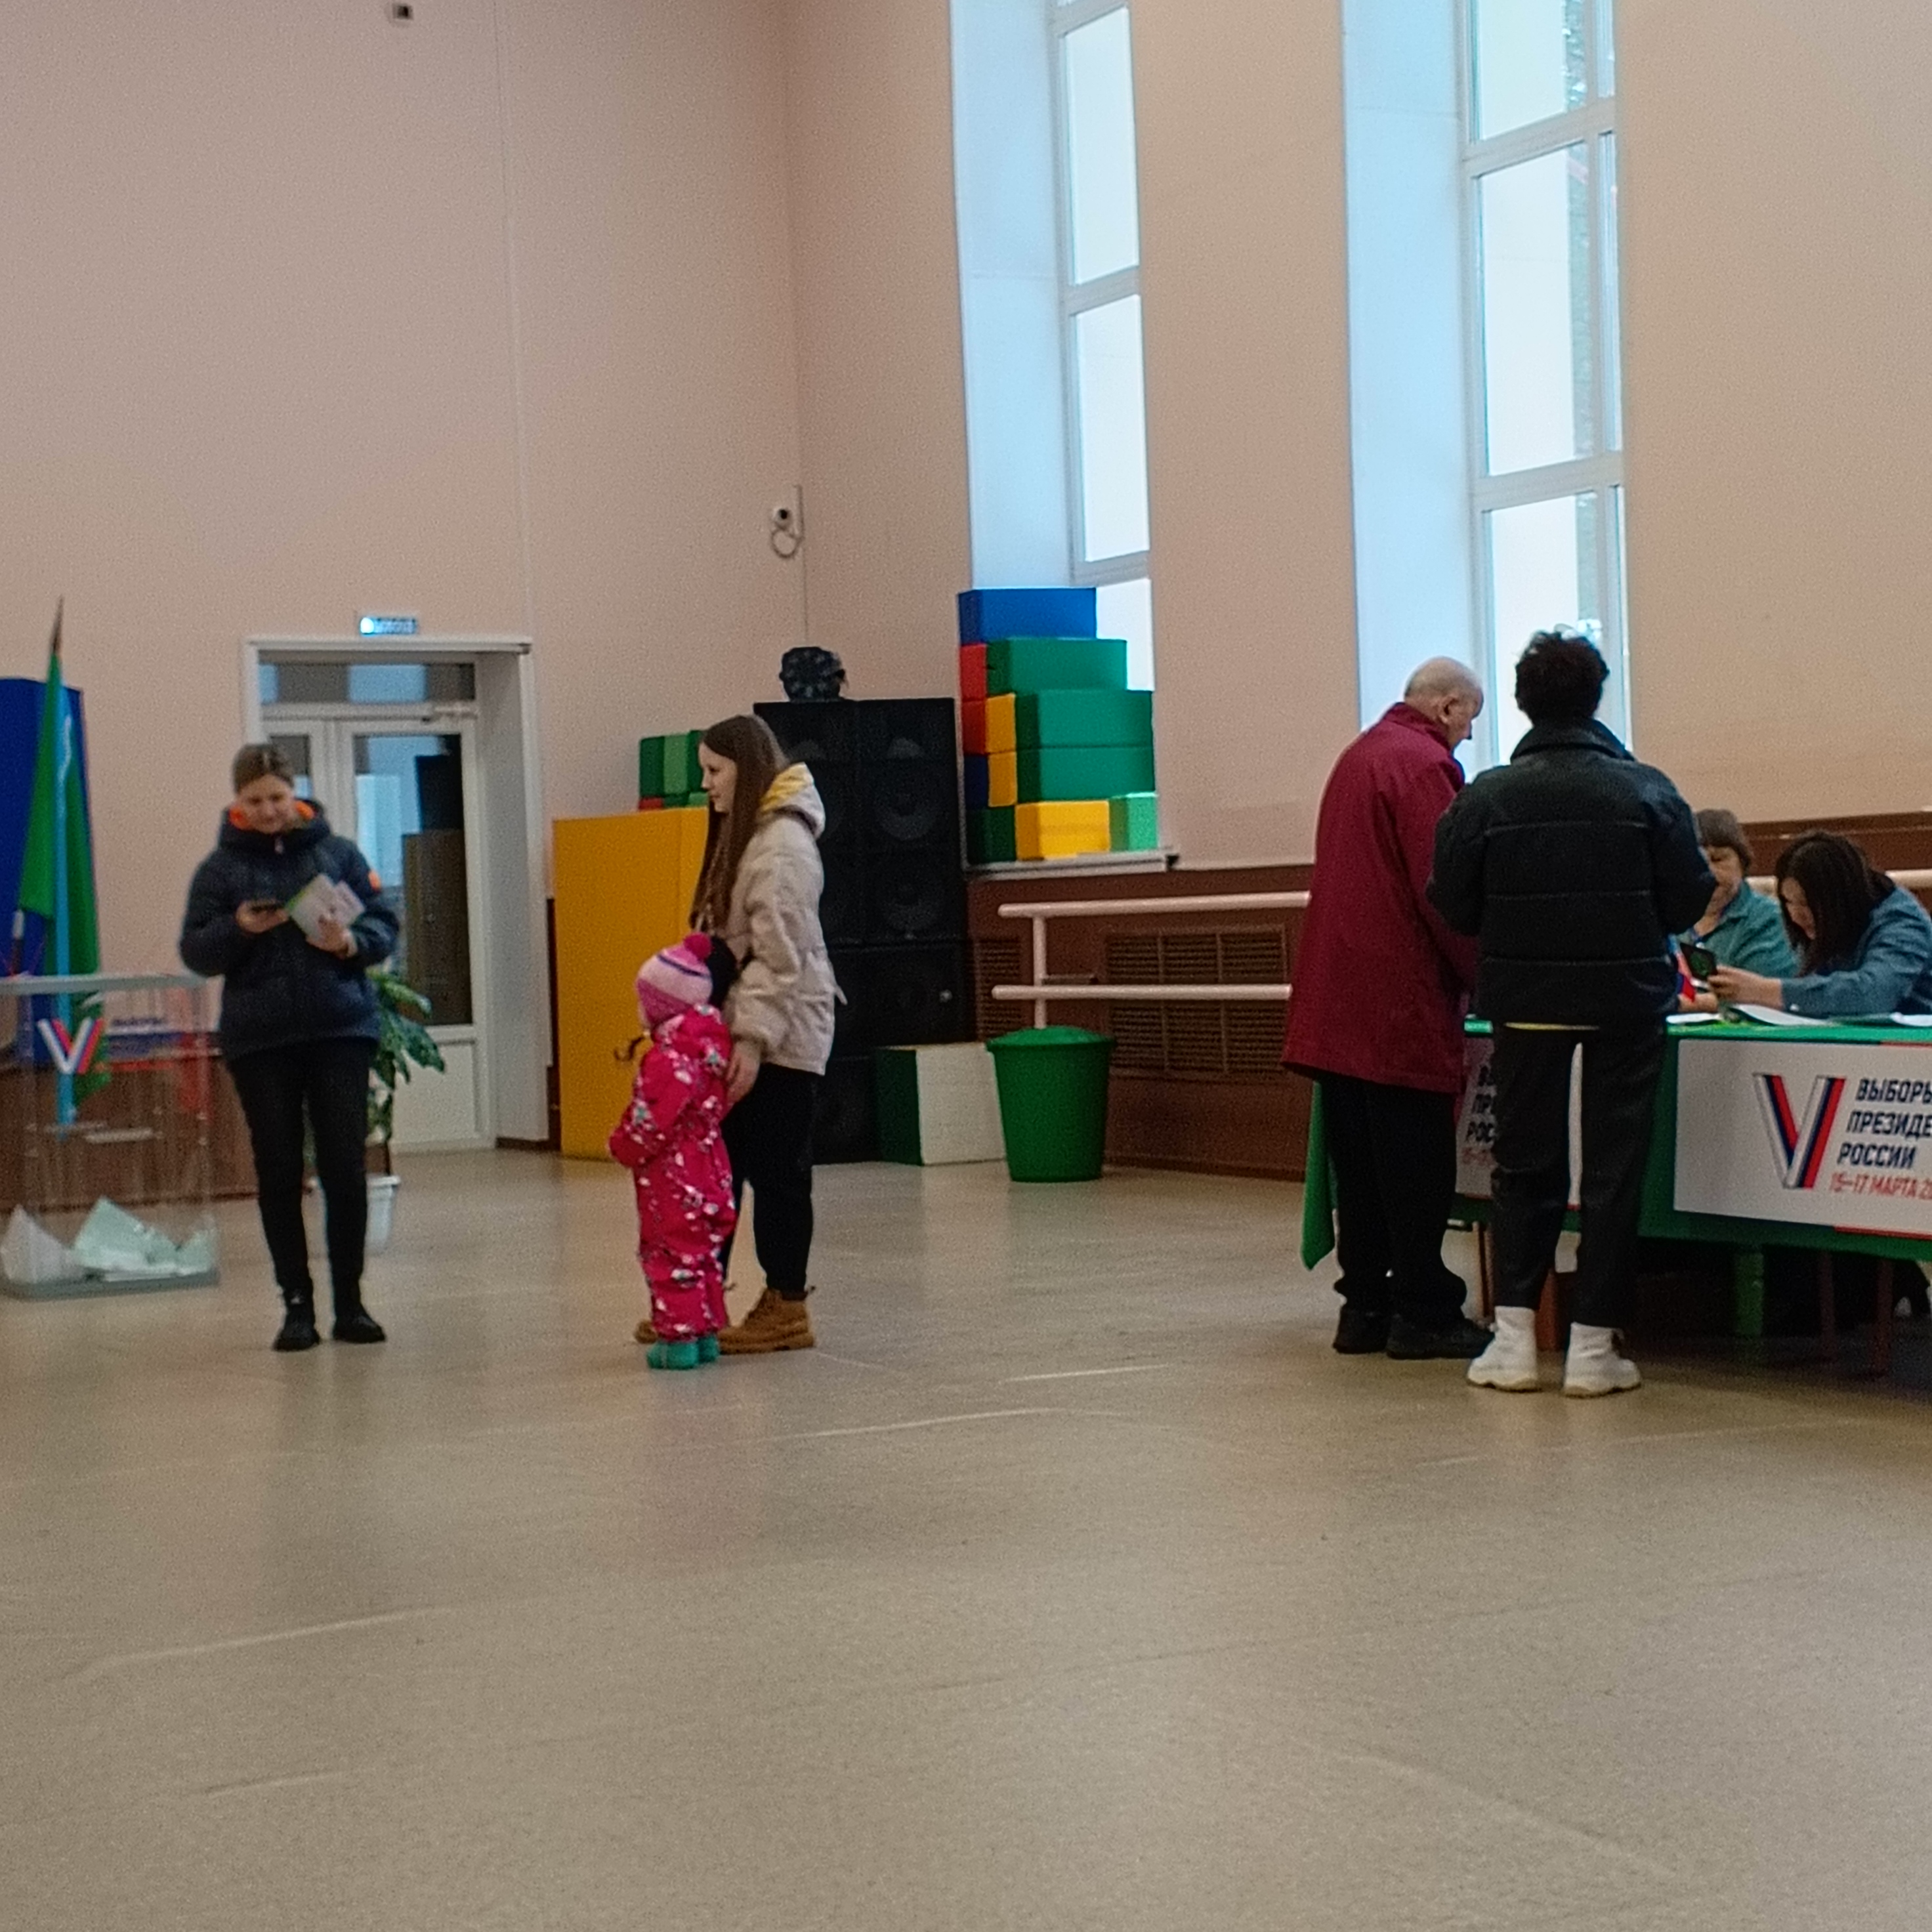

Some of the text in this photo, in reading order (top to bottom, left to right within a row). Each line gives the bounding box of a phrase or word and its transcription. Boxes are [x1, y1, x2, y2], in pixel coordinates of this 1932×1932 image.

[1752, 1072, 1847, 1189] V
[1845, 1110, 1932, 1141] ПРЕЗИДЕ
[1837, 1142, 1916, 1169] РОССИИ
[1868, 1175, 1917, 1198] МАРТА
